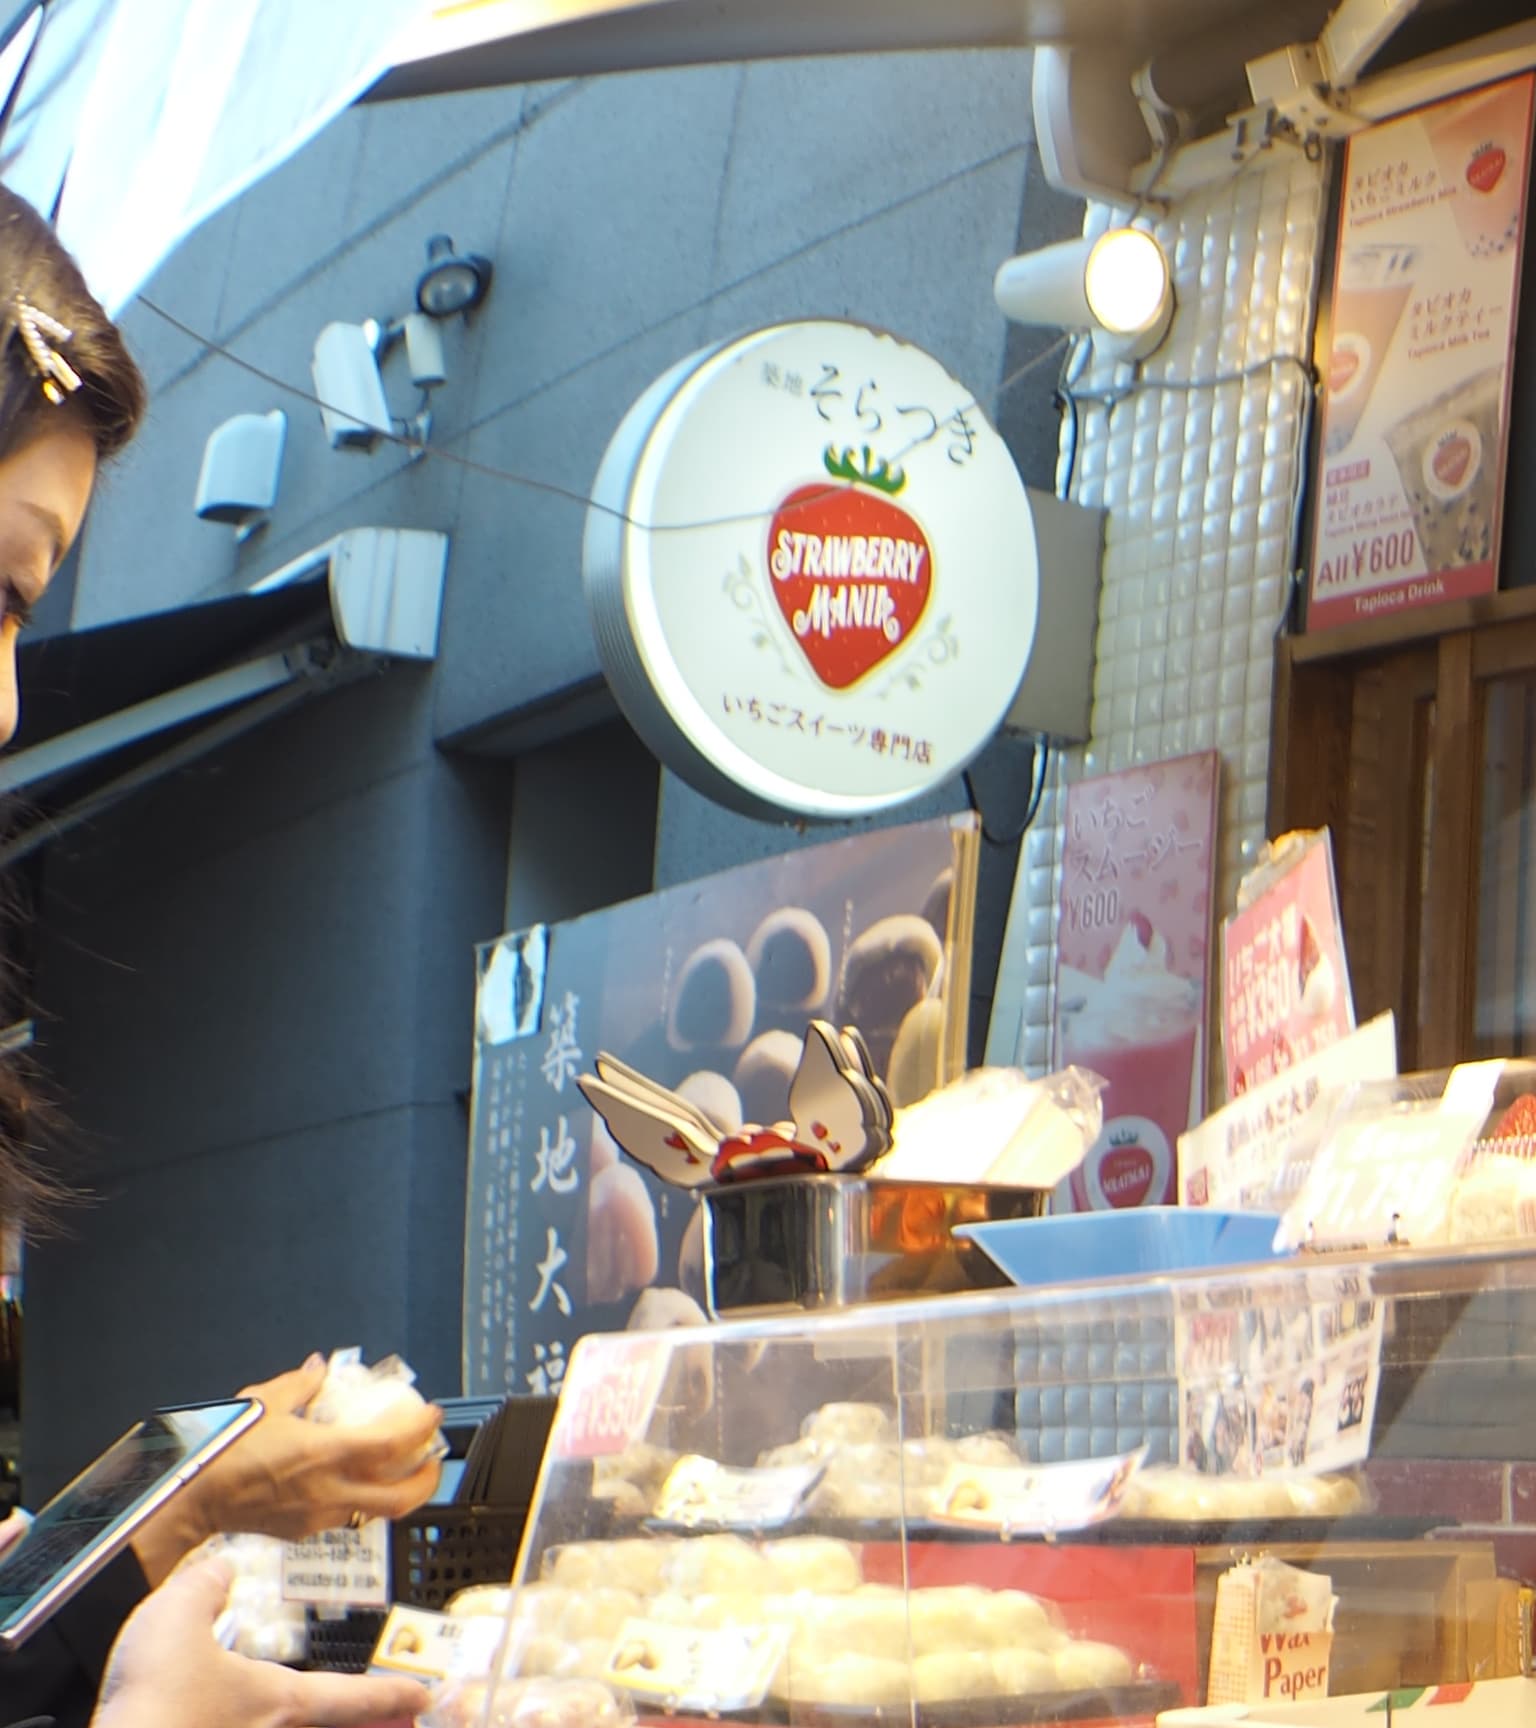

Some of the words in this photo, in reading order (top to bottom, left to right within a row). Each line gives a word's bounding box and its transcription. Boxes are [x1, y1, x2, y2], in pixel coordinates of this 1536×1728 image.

[809, 363, 977, 466] そらつき
[771, 529, 928, 584] STRAWBERRY
[793, 584, 900, 644] MANIA
[1355, 590, 1405, 614] Tapioca
[1407, 579, 1444, 600] Drink
[721, 692, 934, 765] いちごスイーツ専門店
[1072, 783, 1155, 842] いちご
[1069, 891, 1119, 933] ¥600
[1263, 1656, 1327, 1699] Paper
